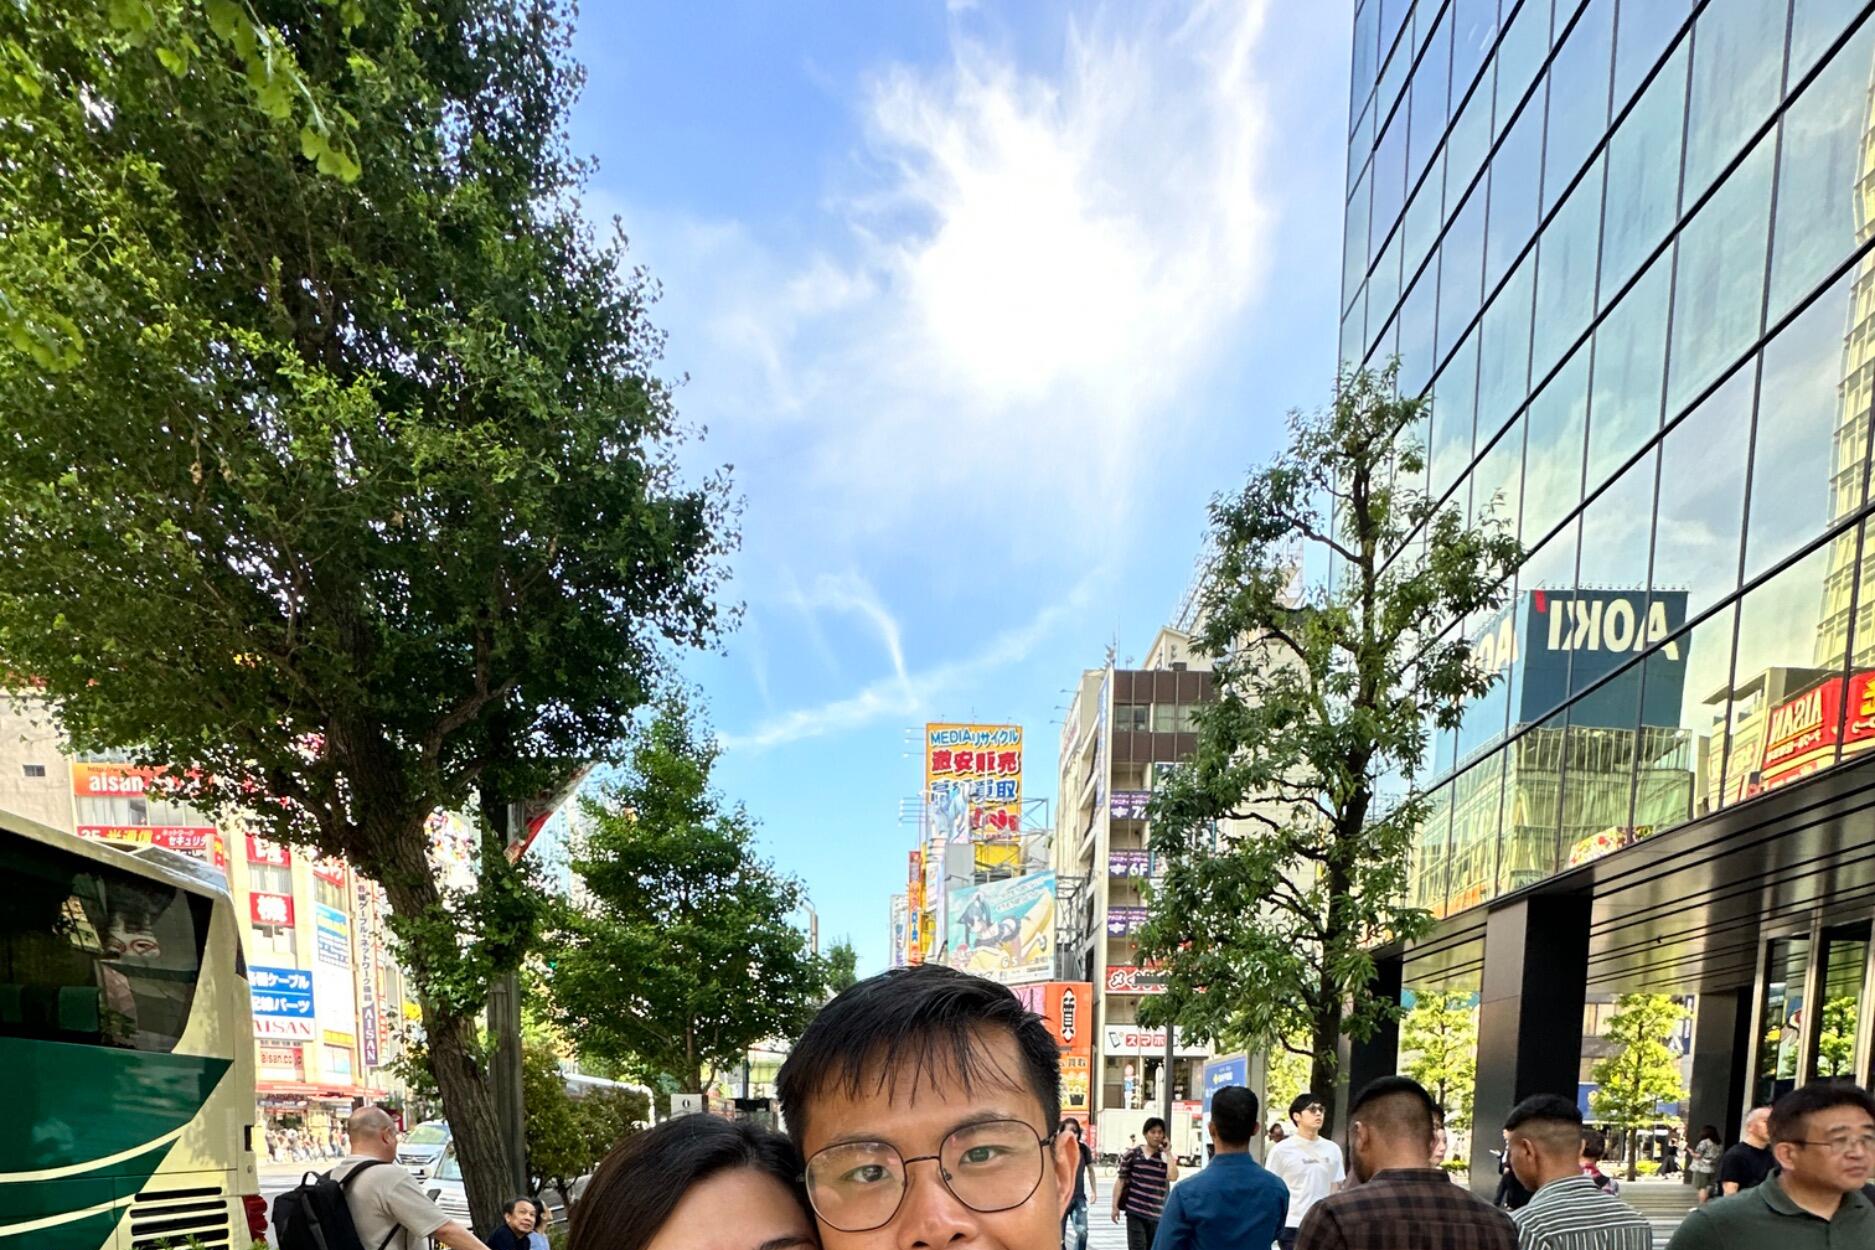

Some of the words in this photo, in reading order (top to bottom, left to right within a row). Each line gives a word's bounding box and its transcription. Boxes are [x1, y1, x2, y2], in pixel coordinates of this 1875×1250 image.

[932, 750, 1017, 773] 激安販売
[931, 779, 1016, 800] 高買取
[1129, 863, 1148, 876] 6F
[364, 1009, 377, 1061] AISAN
[1125, 1034, 1167, 1047] スマホ
